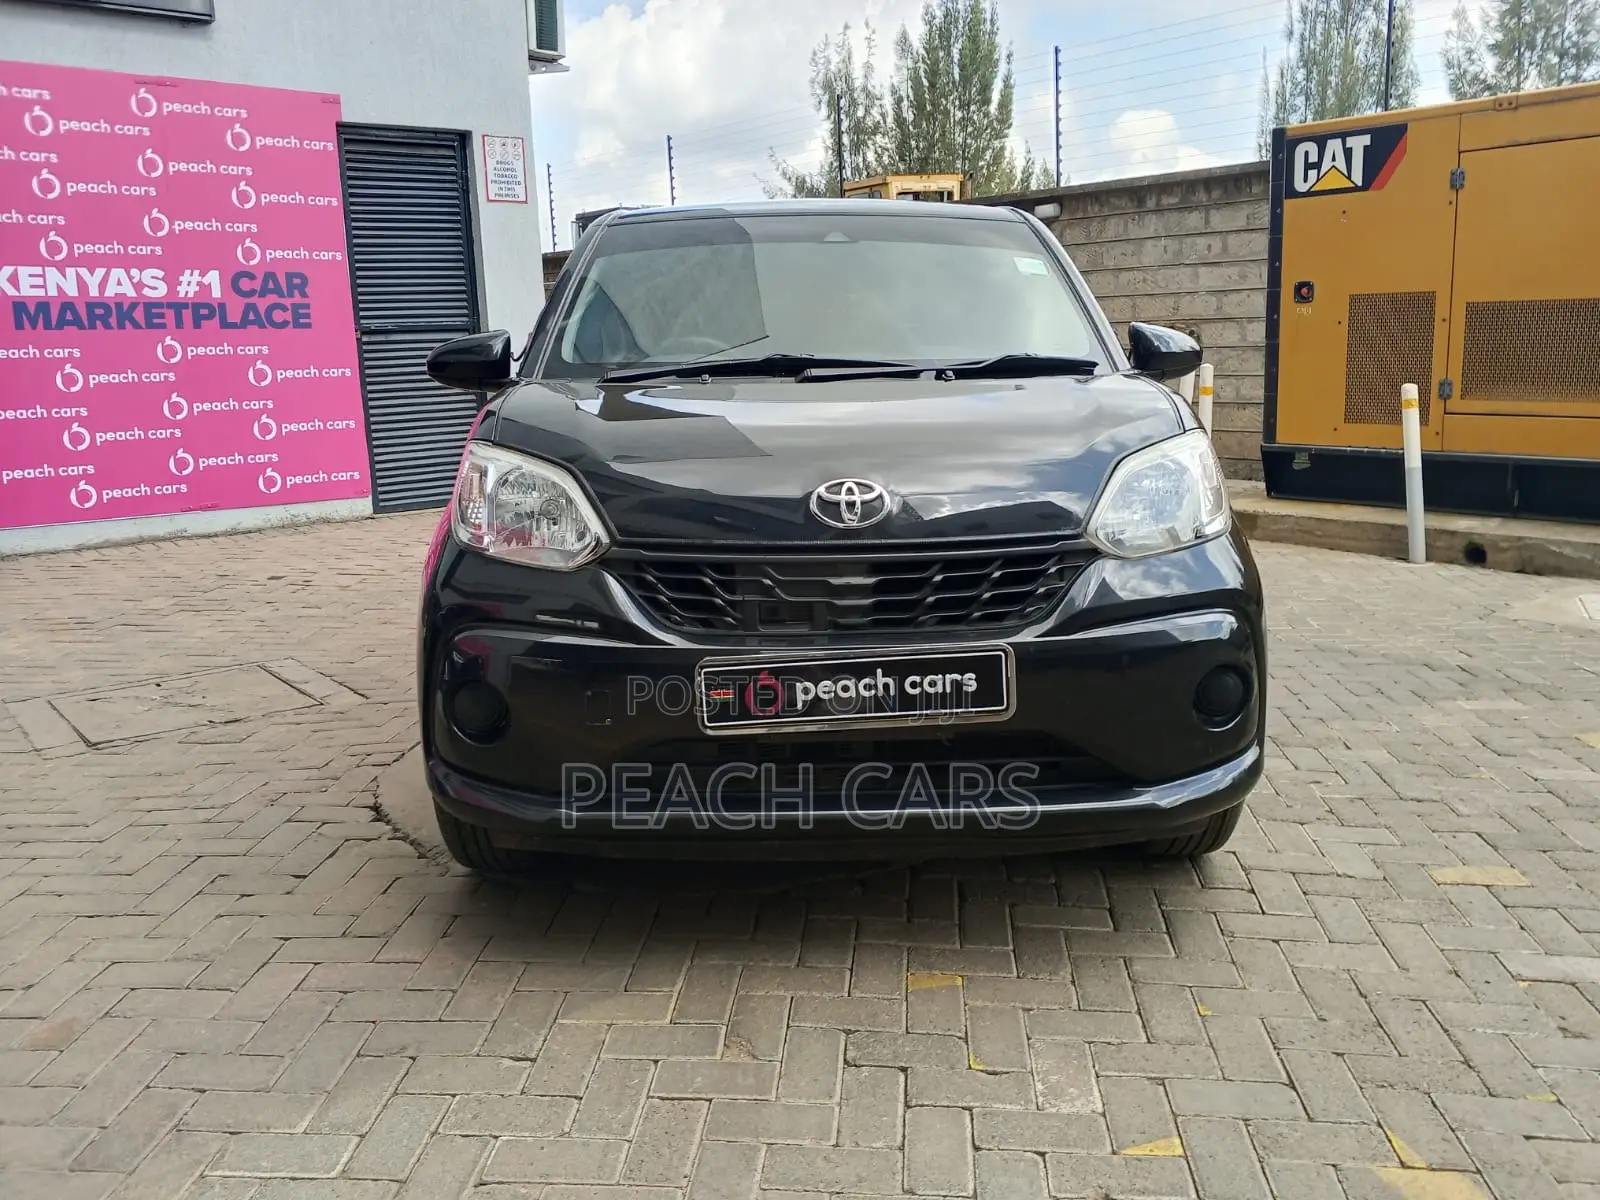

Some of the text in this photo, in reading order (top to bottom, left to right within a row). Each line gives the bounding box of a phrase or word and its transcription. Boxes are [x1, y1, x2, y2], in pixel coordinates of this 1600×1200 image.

[12, 87, 50, 100] cars
[163, 102, 247, 118] peach cars
[60, 119, 150, 136] peach cars
[256, 136, 333, 150] peach cars
[20, 152, 58, 163] cars
[1294, 134, 1371, 192] CAT
[169, 160, 252, 175] peach cars
[67, 181, 156, 196] peach cars
[261, 192, 338, 206] peach cars
[28, 215, 65, 224] cars
[175, 218, 257, 233] peach cars
[74, 241, 162, 257] peach cars
[266, 247, 342, 262] peach cars
[177, 270, 221, 298] #1
[231, 271, 309, 298] CAR
[12, 301, 312, 331] MARKETPLACE
[0, 345, 80, 358] each cars
[187, 343, 268, 359] peach cars
[89, 370, 175, 388] peach cars
[277, 366, 351, 382] peach cars
[52, 408, 88, 417] cars
[193, 398, 273, 415] peach cars
[282, 419, 355, 436] peach cars
[96, 427, 181, 446] peach cars
[199, 452, 278, 470] peach cars
[2, 464, 94, 484] peach cars
[287, 471, 360, 488] peach cars
[103, 484, 187, 503] peach cars
[795, 668, 977, 710] peach cars
